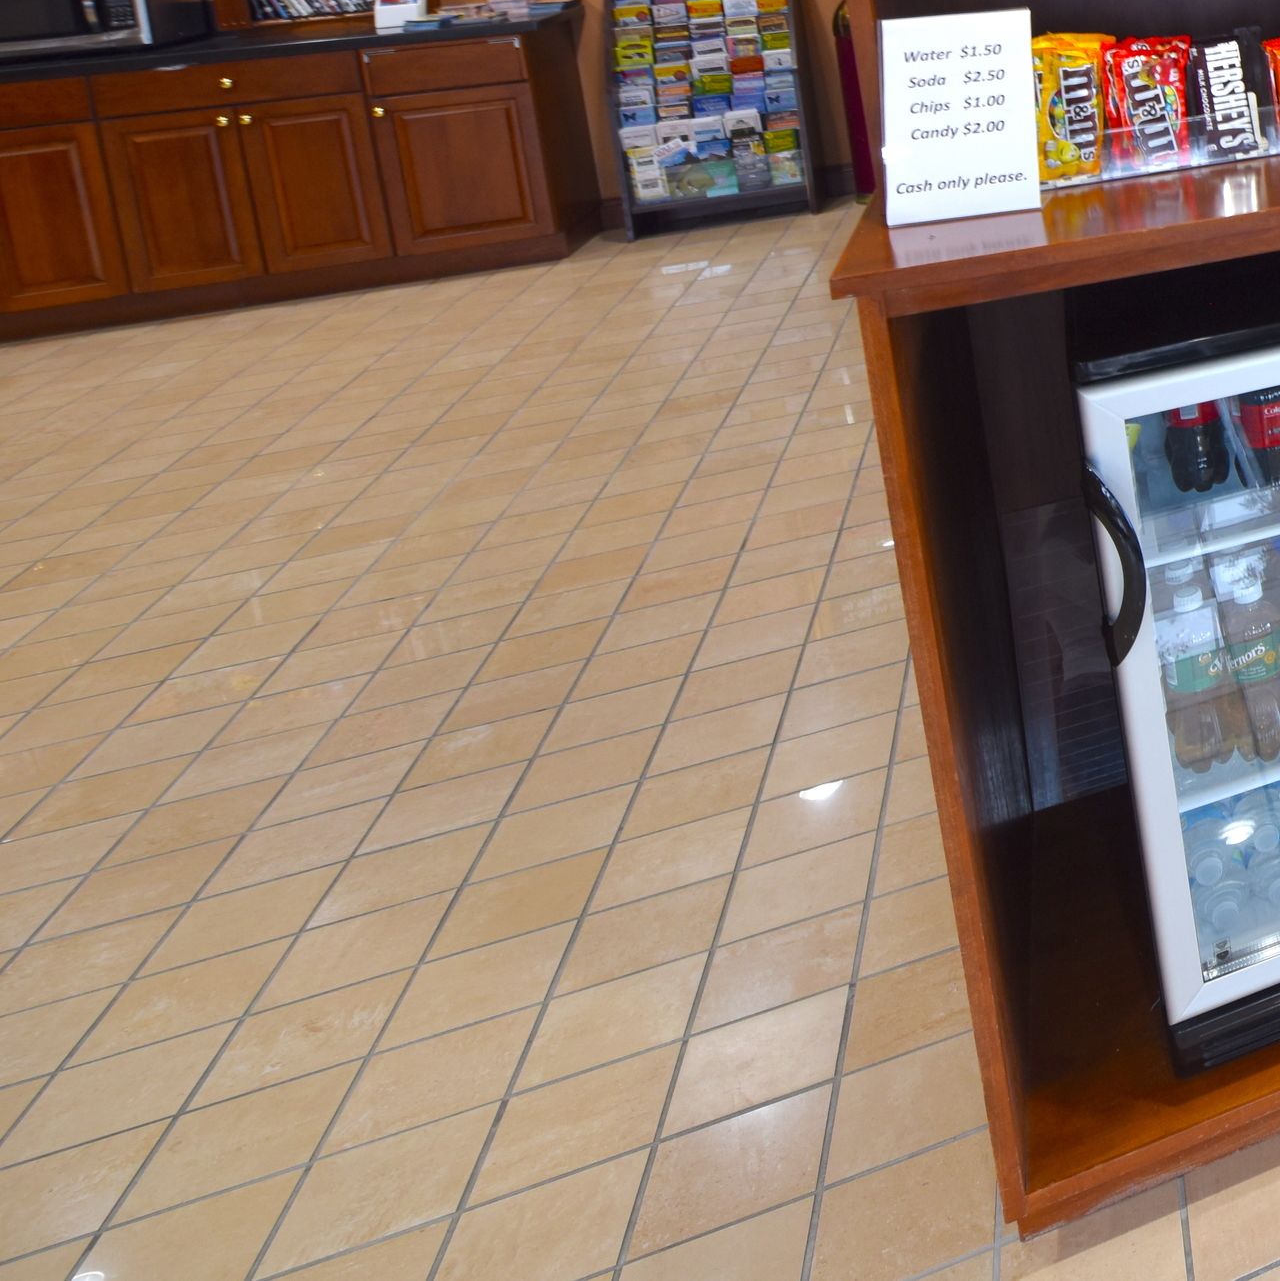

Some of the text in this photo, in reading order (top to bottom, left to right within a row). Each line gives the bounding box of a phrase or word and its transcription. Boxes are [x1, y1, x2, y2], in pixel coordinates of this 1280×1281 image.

[903, 44, 1002, 63] Water $1.50
[908, 69, 1006, 89] Soda $2.50
[909, 94, 1006, 116] Chips $1.00
[1204, 40, 1258, 151] HERSHEY'S
[910, 120, 1006, 141] Candy $2.00
[895, 171, 1029, 195] Cash only please.
